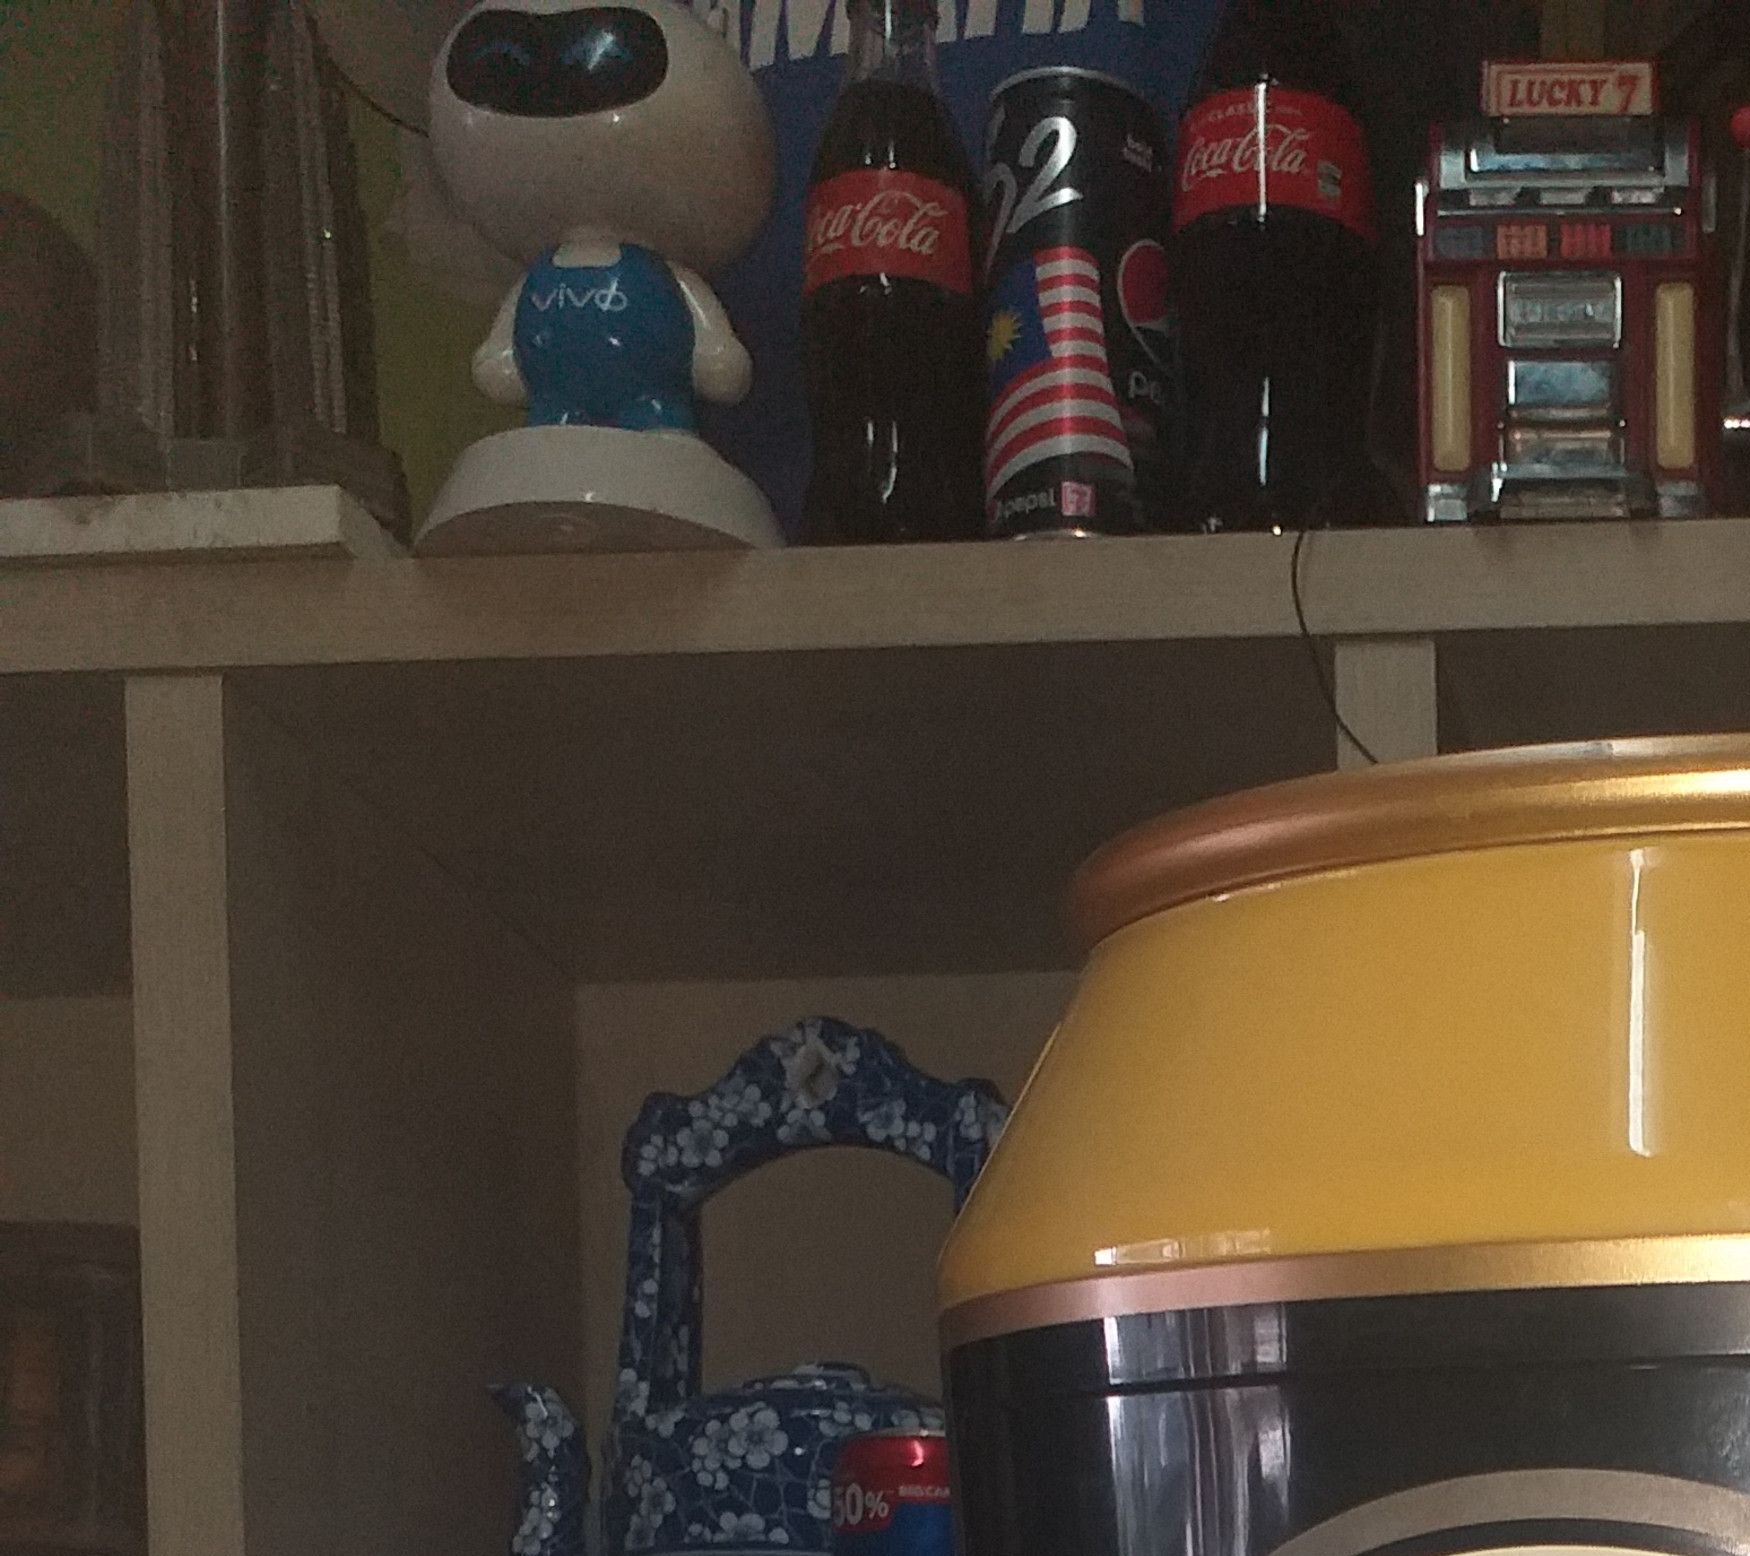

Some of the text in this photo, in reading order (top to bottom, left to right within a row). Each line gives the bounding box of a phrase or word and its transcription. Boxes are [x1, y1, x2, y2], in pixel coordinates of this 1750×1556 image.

[1509, 74, 1639, 113] LUCKY 7
[1182, 124, 1311, 192] Coca-Cla
[531, 279, 628, 312] vivo
